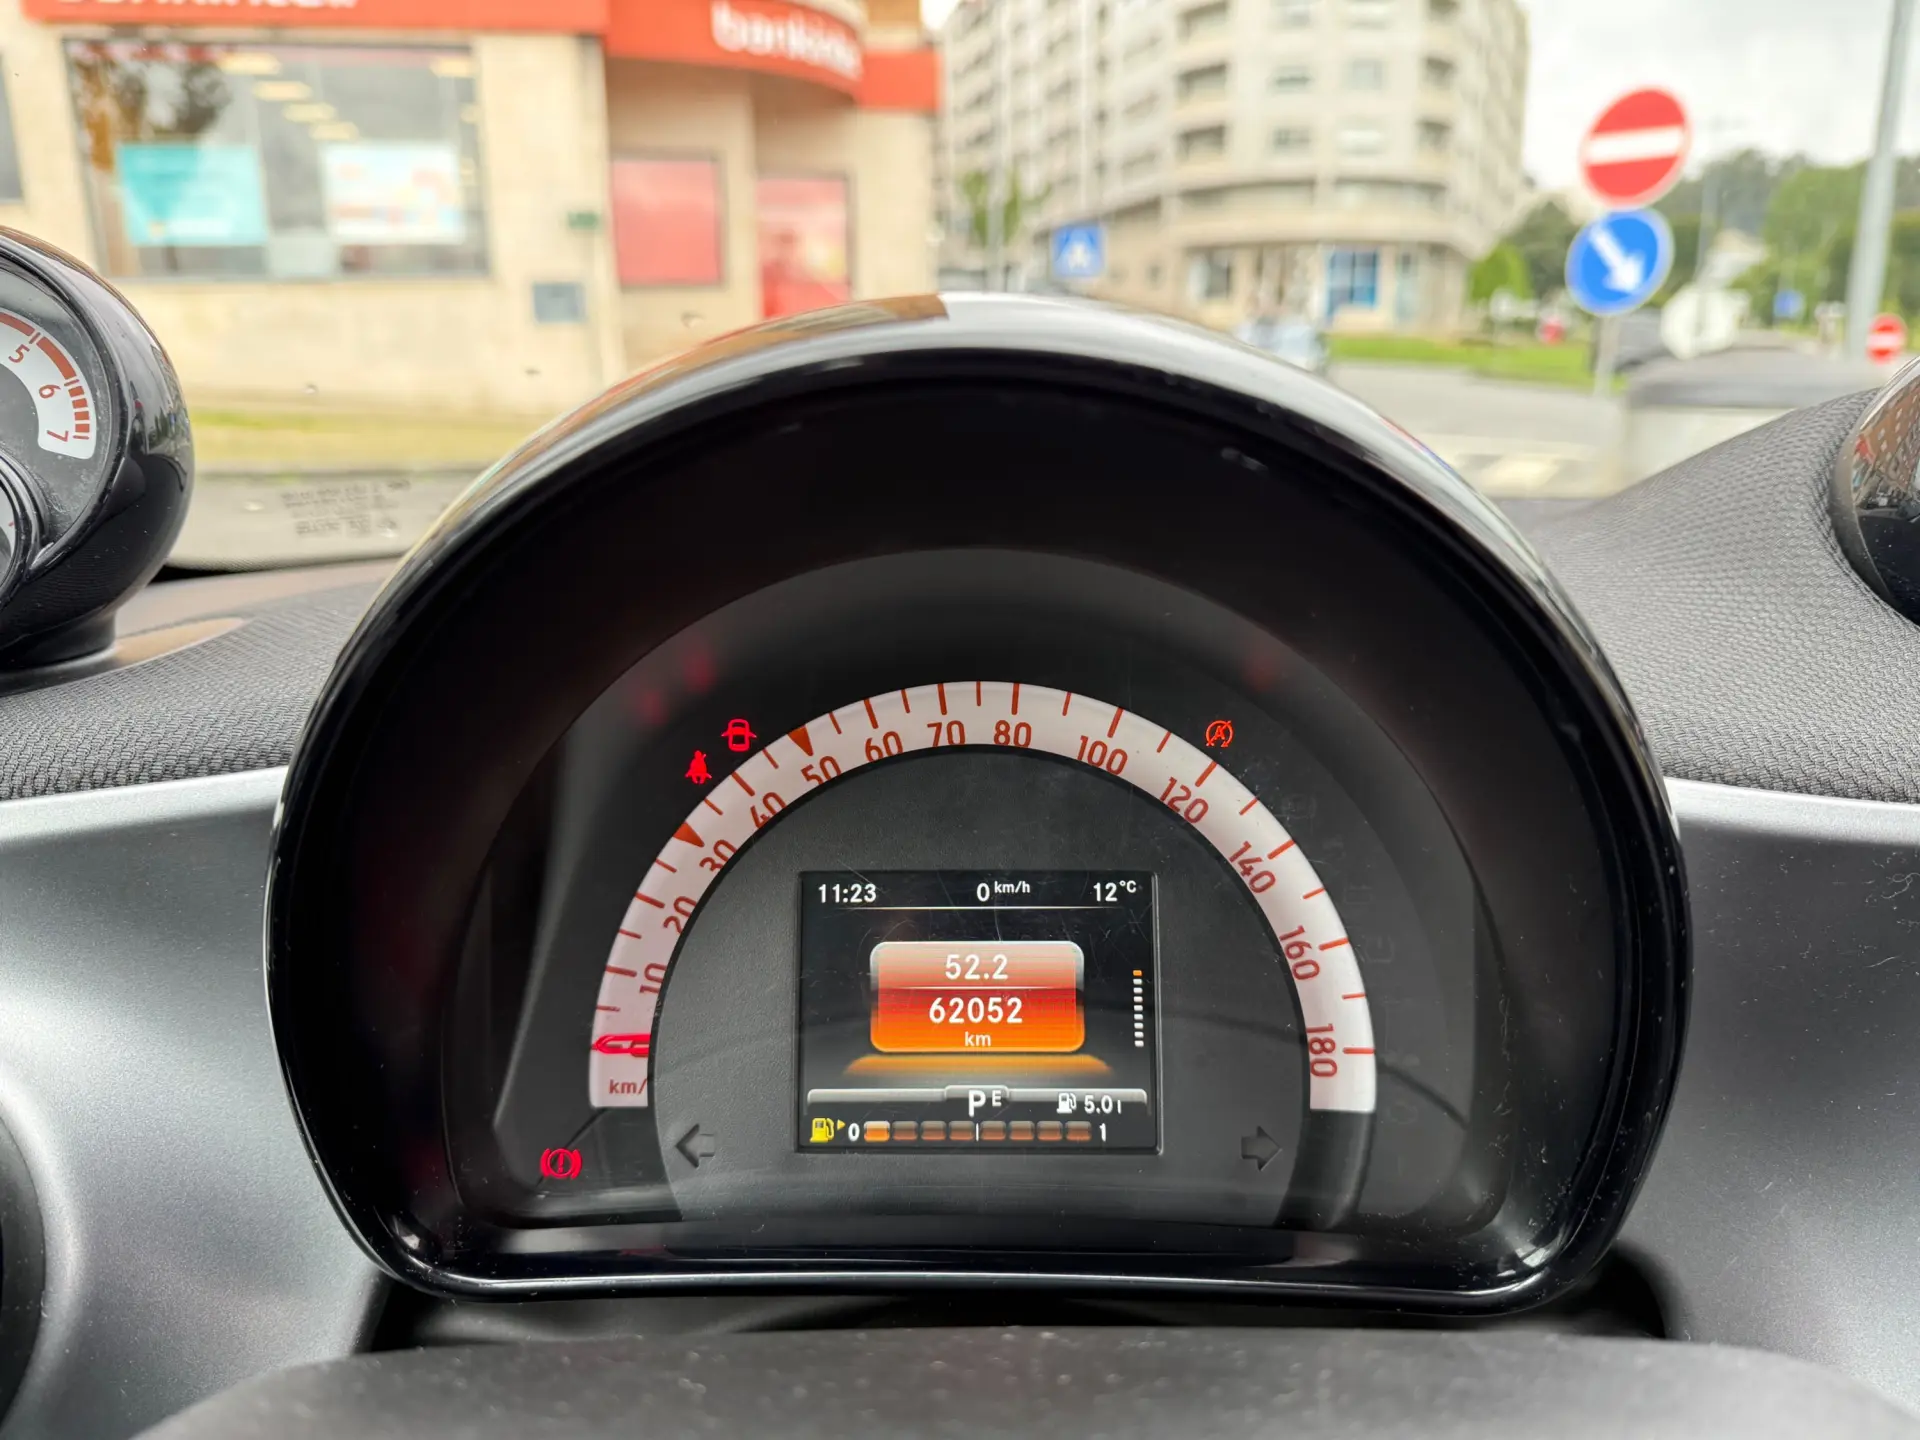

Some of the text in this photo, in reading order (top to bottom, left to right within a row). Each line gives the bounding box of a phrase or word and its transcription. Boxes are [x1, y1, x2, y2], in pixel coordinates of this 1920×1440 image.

[8, 344, 30, 363] 5
[38, 384, 61, 399] 6
[46, 430, 69, 443] 7
[865, 731, 904, 763] 60
[927, 720, 966, 747] 70
[993, 720, 1032, 748] 80
[1077, 735, 1128, 776] 100
[801, 756, 842, 787] 50
[749, 791, 786, 829] 40
[1160, 776, 1209, 824] 120
[699, 839, 738, 872] 30
[1229, 841, 1276, 894] 140
[818, 883, 877, 904] 11:23
[976, 880, 1031, 902] 0 km/h
[663, 896, 697, 934] 20
[945, 954, 1009, 980] 52.2
[1279, 925, 1320, 981] 160
[639, 963, 668, 994] 10
[928, 997, 1023, 1024] 62052
[964, 1032, 992, 1048] km
[1305, 1022, 1338, 1079] 180
[968, 1089, 1003, 1117] P E
[1084, 1095, 1113, 1113] 5.0
[847, 1124, 861, 1142] 0
[1098, 1124, 1108, 1142] 1
